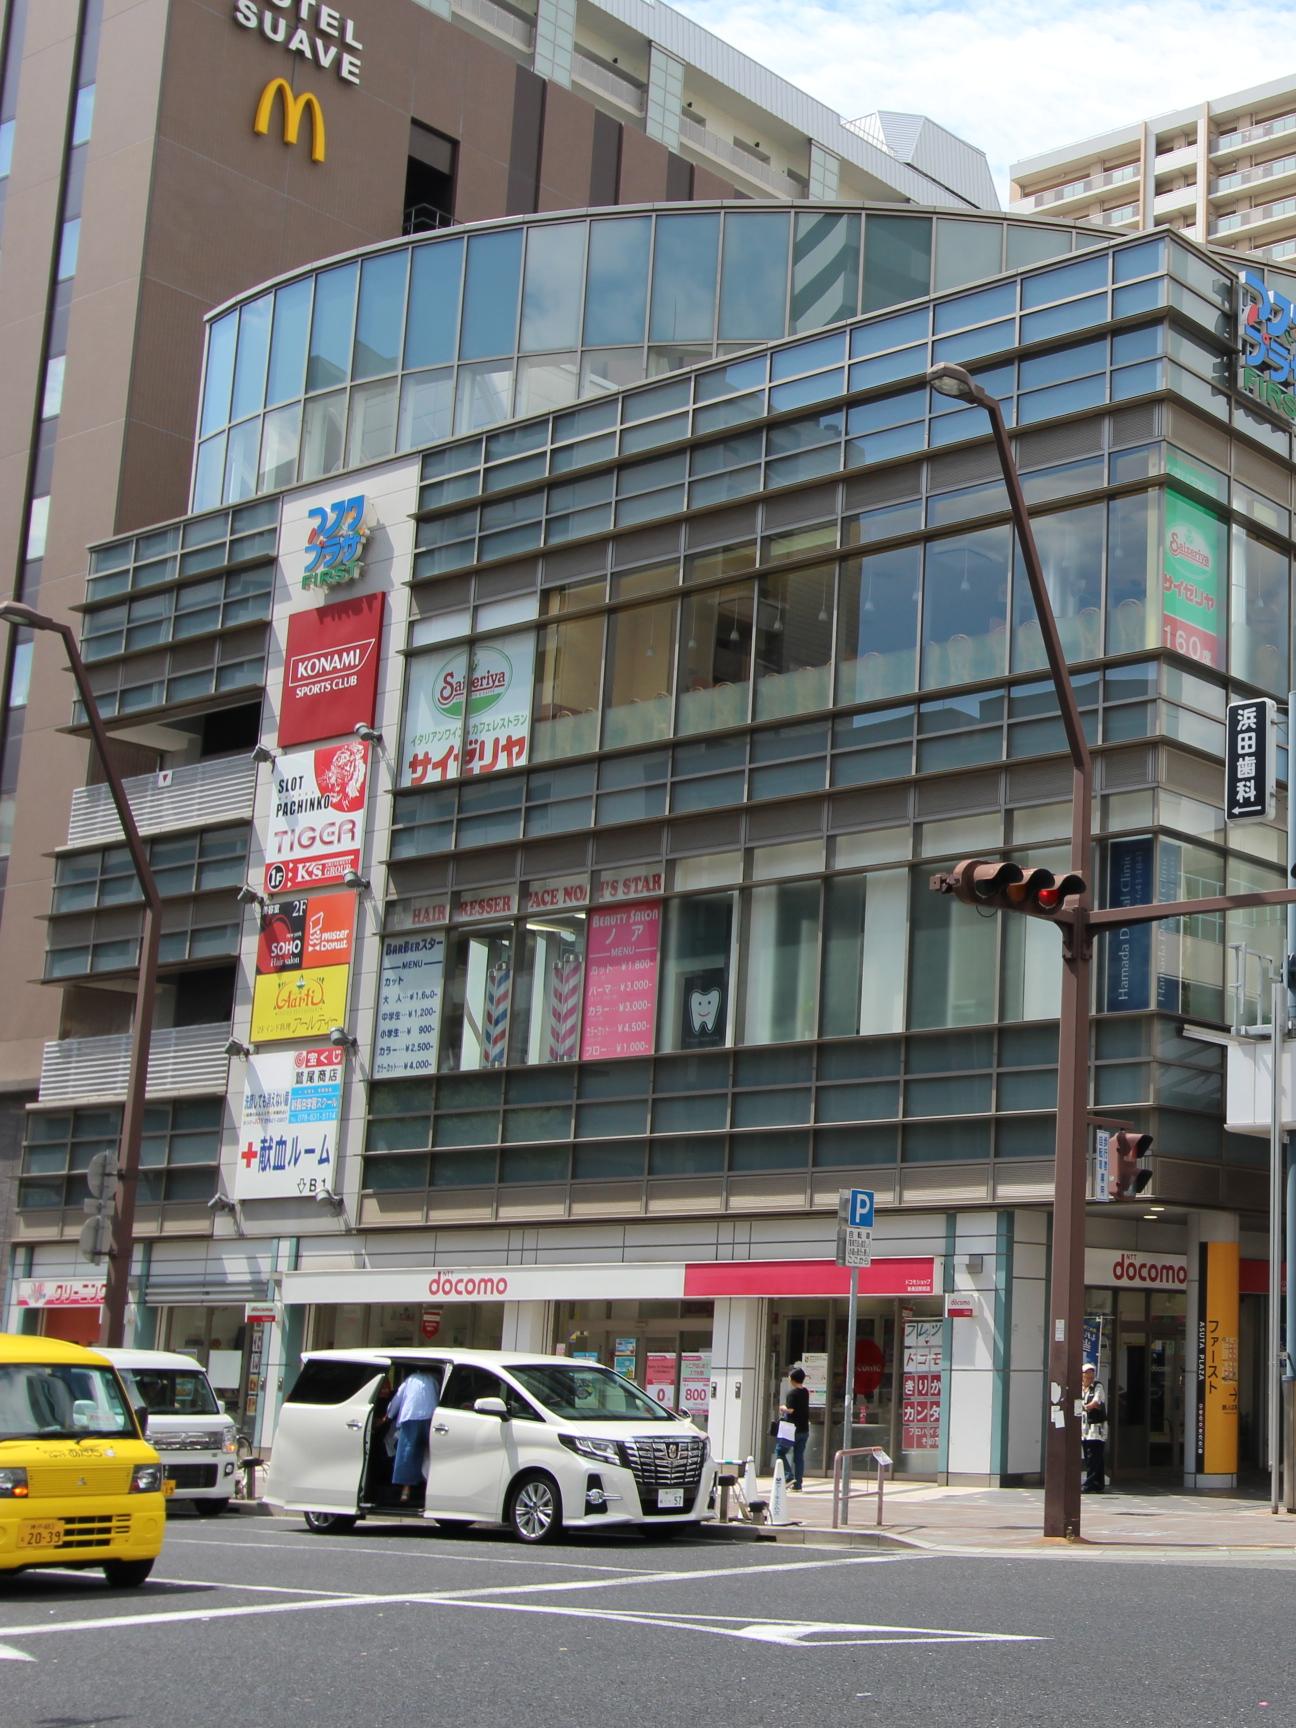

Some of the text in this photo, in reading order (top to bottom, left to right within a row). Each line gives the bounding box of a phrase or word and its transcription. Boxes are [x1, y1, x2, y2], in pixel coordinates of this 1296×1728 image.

[271, 0, 363, 50] TEL
[235, 0, 361, 84] SUAVE
[301, 560, 361, 590] FIRST
[297, 648, 360, 678] KONAMI
[295, 675, 358, 698] SPORTS CLUB
[437, 670, 505, 706] Saieriya
[411, 714, 528, 747] イタリアンワイカフェレストラン
[1236, 706, 1257, 803] 浜田歯科
[278, 775, 304, 794] SLOT
[275, 794, 330, 818] PACHINKO
[274, 819, 356, 855] TIGER
[269, 867, 284, 887] 1F
[292, 900, 307, 917] 2F
[412, 903, 446, 925] HAIR
[459, 895, 512, 916] RESSER
[622, 873, 662, 895] STAR
[321, 929, 349, 940] mister
[321, 941, 348, 951] Donut
[271, 940, 301, 957] SOHO
[402, 959, 423, 970] MENU
[1118, 945, 1130, 1000] Hamada
[384, 977, 404, 987] カット
[381, 1011, 401, 1021] 中学生
[380, 1028, 400, 1038] 小学生
[307, 1050, 341, 1066] 宝くじ
[378, 1047, 397, 1056] カラー
[258, 1134, 330, 1173] 献血ルーム
[856, 1194, 870, 1223] P
[1113, 1254, 1187, 1284] docomo
[429, 1272, 507, 1295] docomo
[906, 1352, 941, 1366] ドコモ
[1208, 1320, 1219, 1394] ファースト
[685, 1388, 706, 1401] 800
[28, 1530, 61, 1544] 20-39
